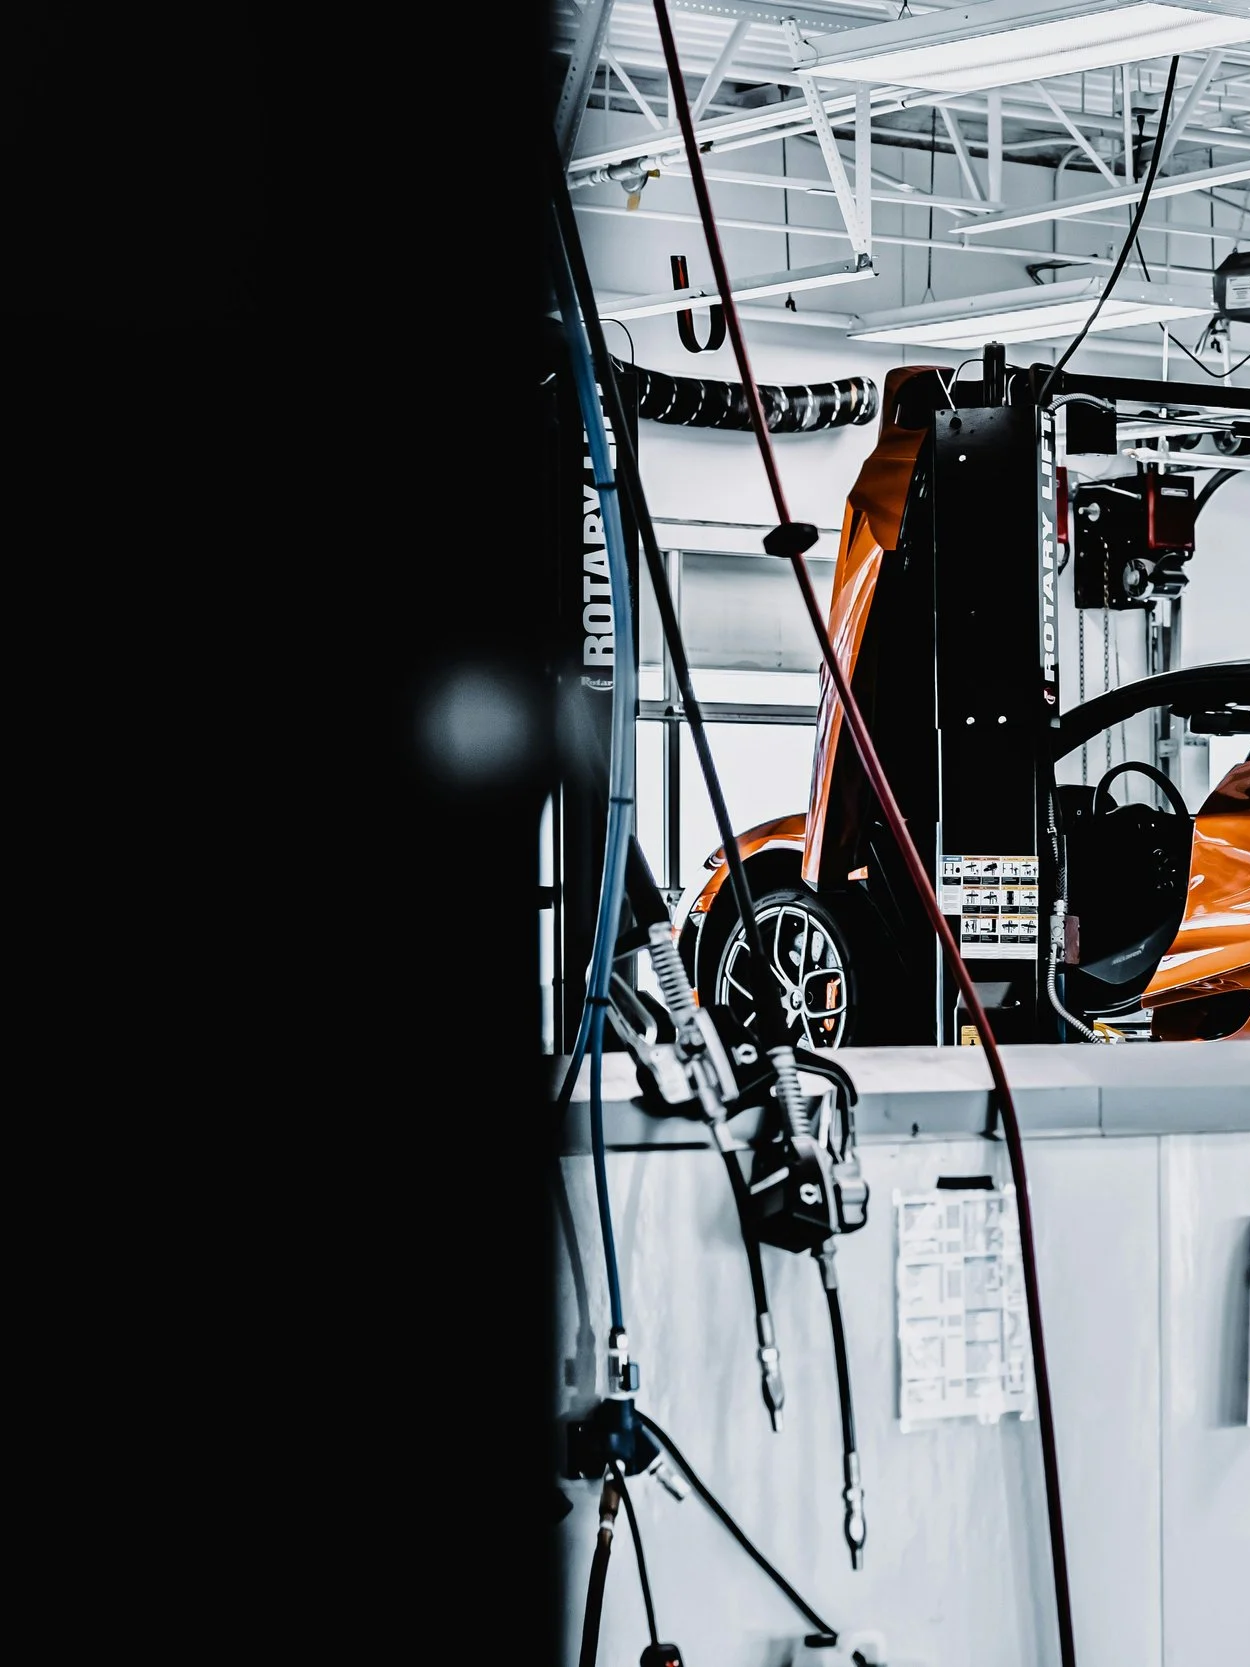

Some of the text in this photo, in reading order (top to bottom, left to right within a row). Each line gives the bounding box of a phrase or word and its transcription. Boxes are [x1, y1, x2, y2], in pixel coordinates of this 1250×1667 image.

[1041, 411, 1055, 500] LIFT
[1041, 511, 1056, 682] ROTARY
[580, 676, 614, 691] Rotar
